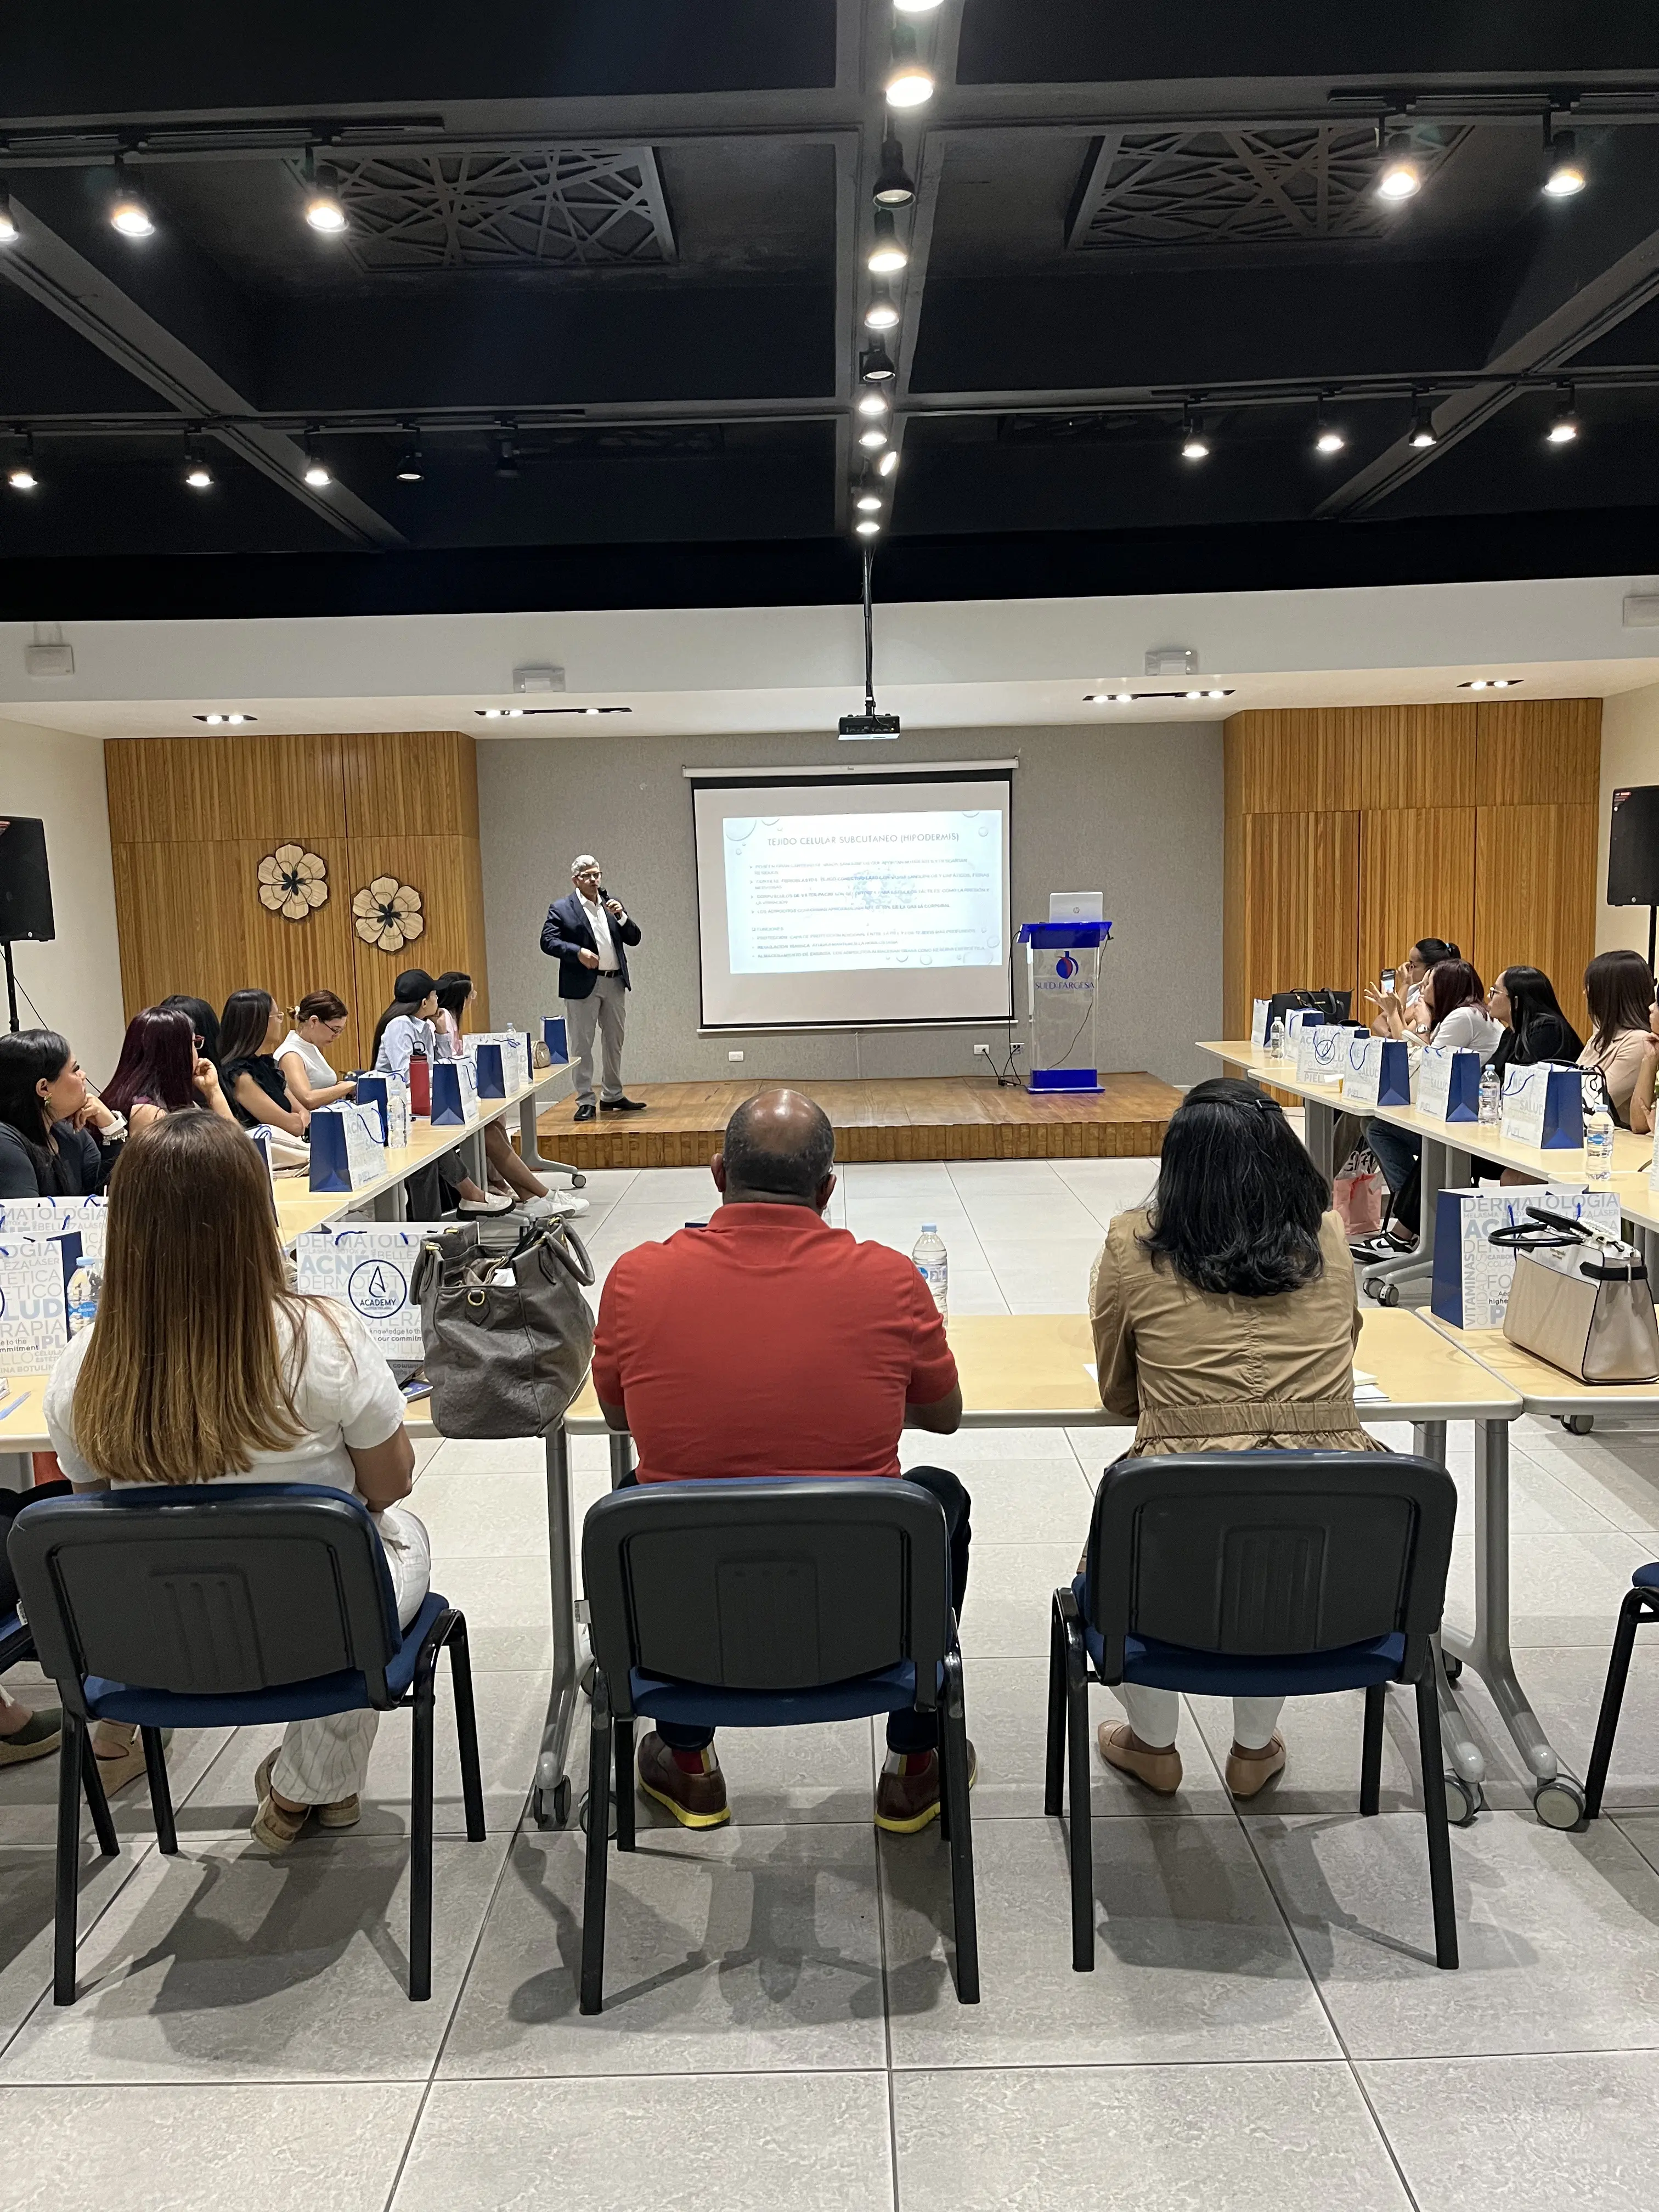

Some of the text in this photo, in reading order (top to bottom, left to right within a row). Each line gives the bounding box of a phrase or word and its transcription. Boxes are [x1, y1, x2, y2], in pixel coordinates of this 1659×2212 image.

[768, 833, 959, 846] TEJIDO CELULAR SUBCUTANEO (HIPODERMIS)
[1464, 1193, 1618, 1212] DERMATOLOGIA
[1464, 1253, 1476, 1326] VITAMINAS
[1476, 1253, 1488, 1325] CUIDADOS
[35, 1334, 65, 1349] IPL
